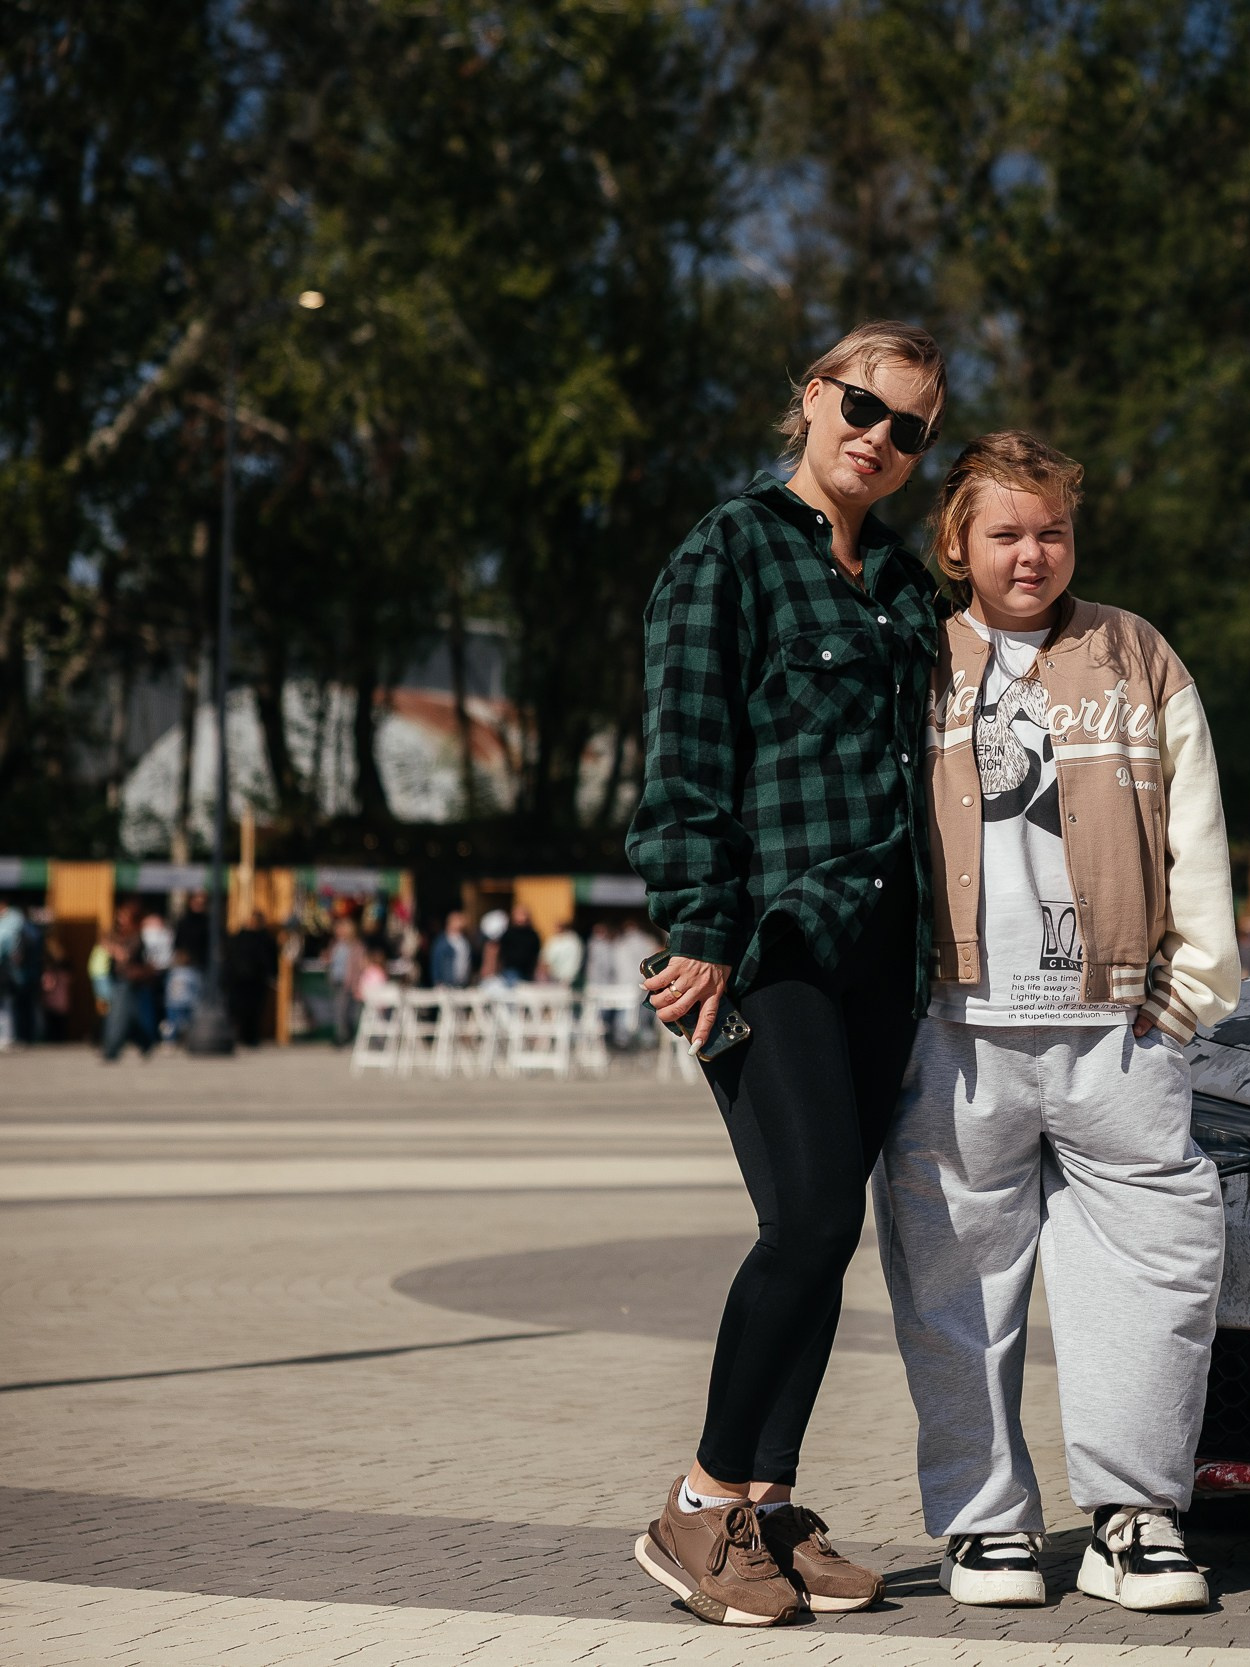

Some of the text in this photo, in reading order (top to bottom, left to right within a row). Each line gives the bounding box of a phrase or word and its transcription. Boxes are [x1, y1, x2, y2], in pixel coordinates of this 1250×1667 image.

[977, 744, 1005, 756] EP IN
[980, 759, 1001, 771] UCH
[1043, 974, 1057, 983] (as
[1020, 1012, 1060, 1020] stupefied
